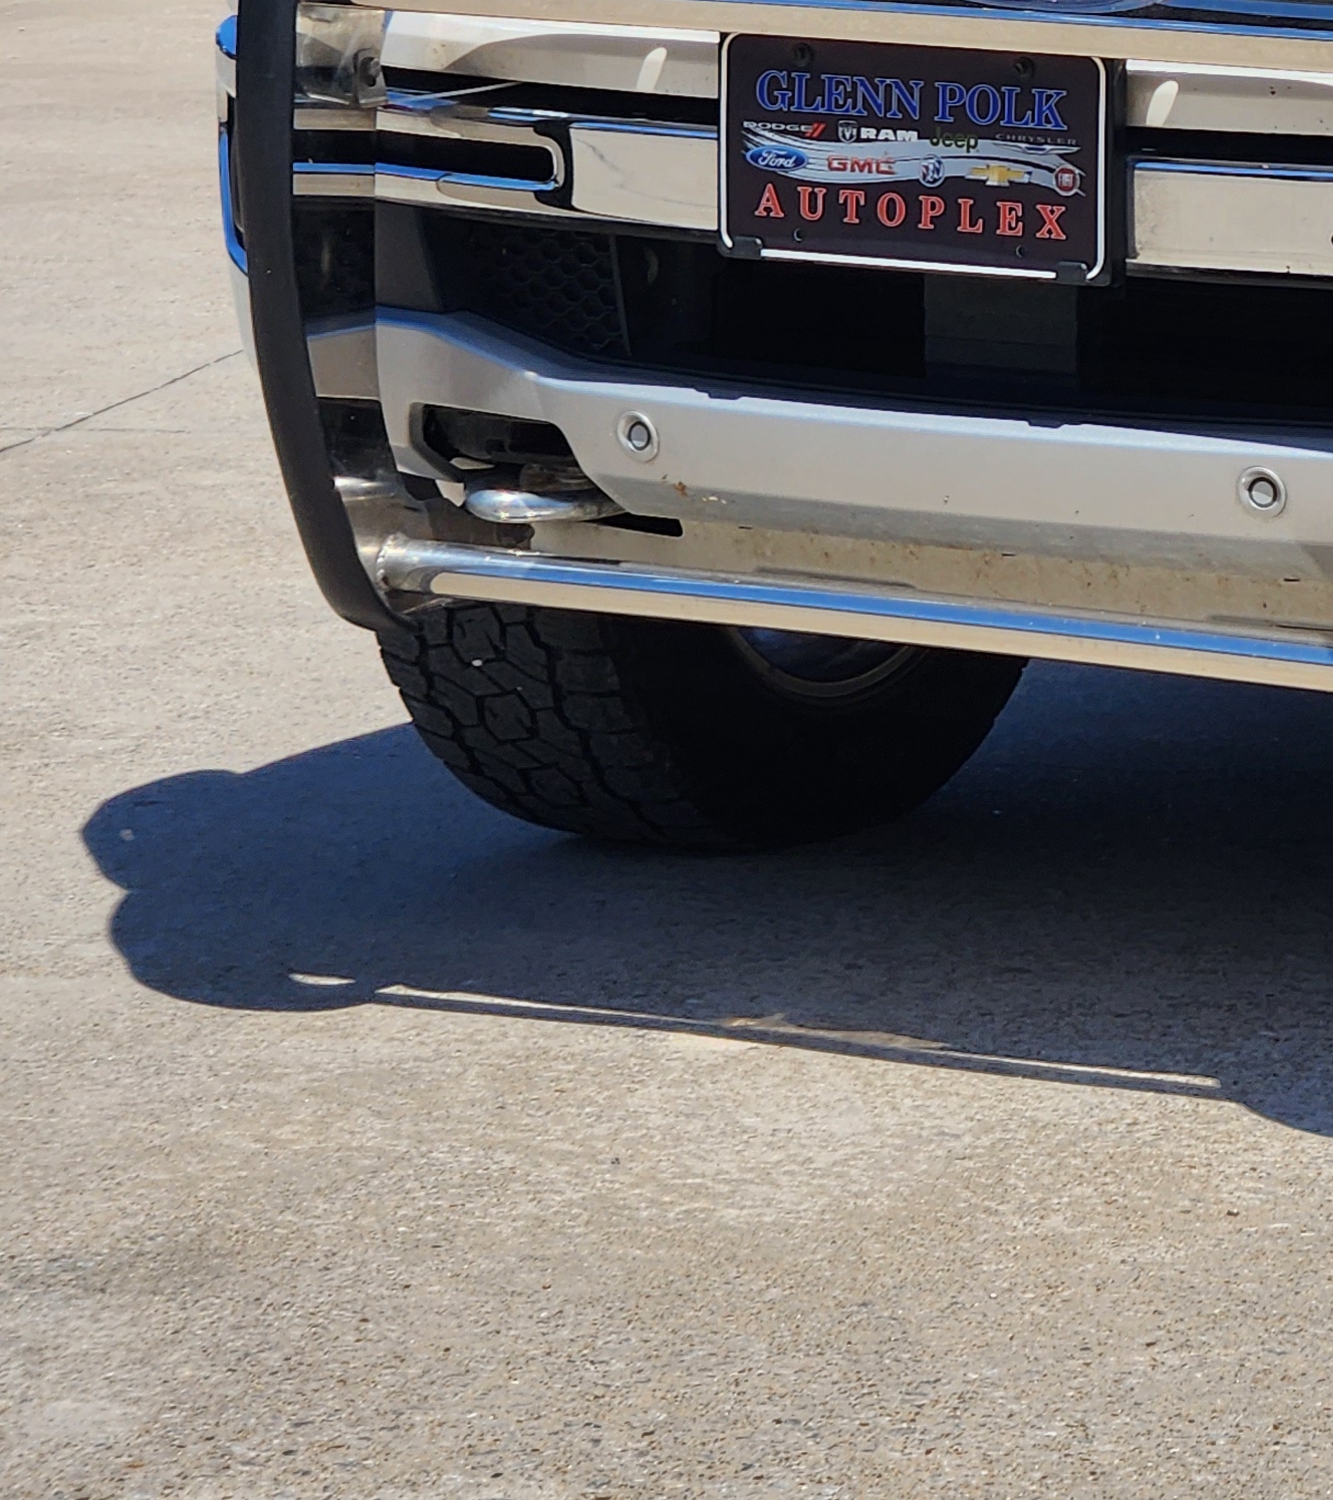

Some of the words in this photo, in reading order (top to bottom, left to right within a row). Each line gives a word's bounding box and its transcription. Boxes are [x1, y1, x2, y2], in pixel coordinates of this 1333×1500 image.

[756, 69, 925, 119] GLENN
[933, 81, 1069, 131] POLK
[860, 127, 919, 142] RAM
[929, 126, 979, 153] Jeep
[757, 149, 796, 169] Ford
[827, 154, 896, 175] GMC
[755, 183, 1067, 241] AUTOPLEX
